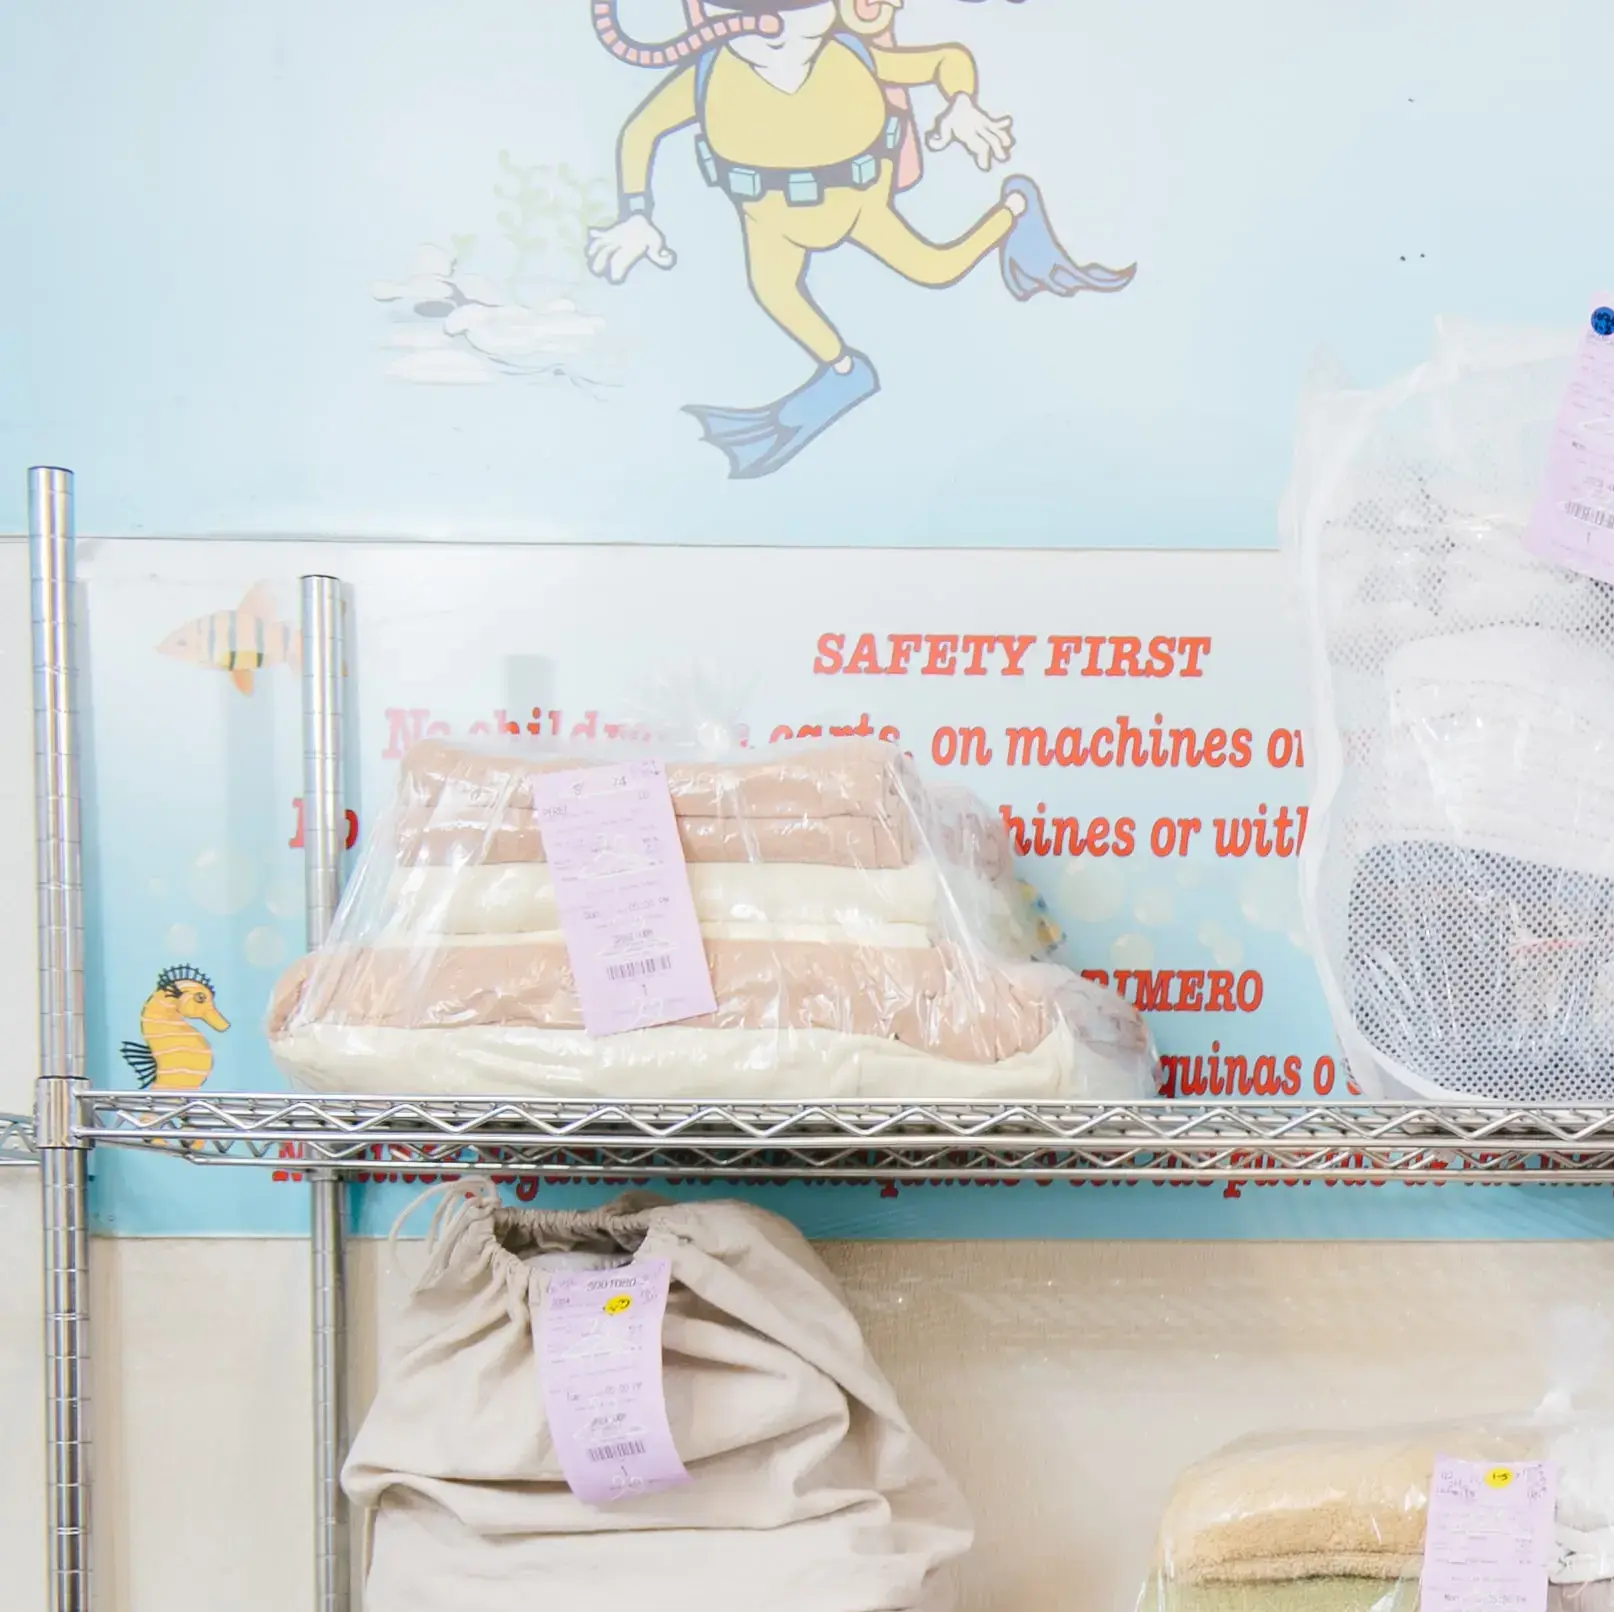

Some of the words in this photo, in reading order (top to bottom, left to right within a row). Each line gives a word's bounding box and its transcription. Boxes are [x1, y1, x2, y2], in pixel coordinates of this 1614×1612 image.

[813, 633, 1035, 679] SAFETY
[1044, 635, 1211, 679] FIRST
[932, 726, 992, 767] on
[1005, 712, 1253, 768] machines
[1150, 816, 1202, 857] or
[1157, 1040, 1301, 1098] quinas
[1313, 1054, 1336, 1096] o
